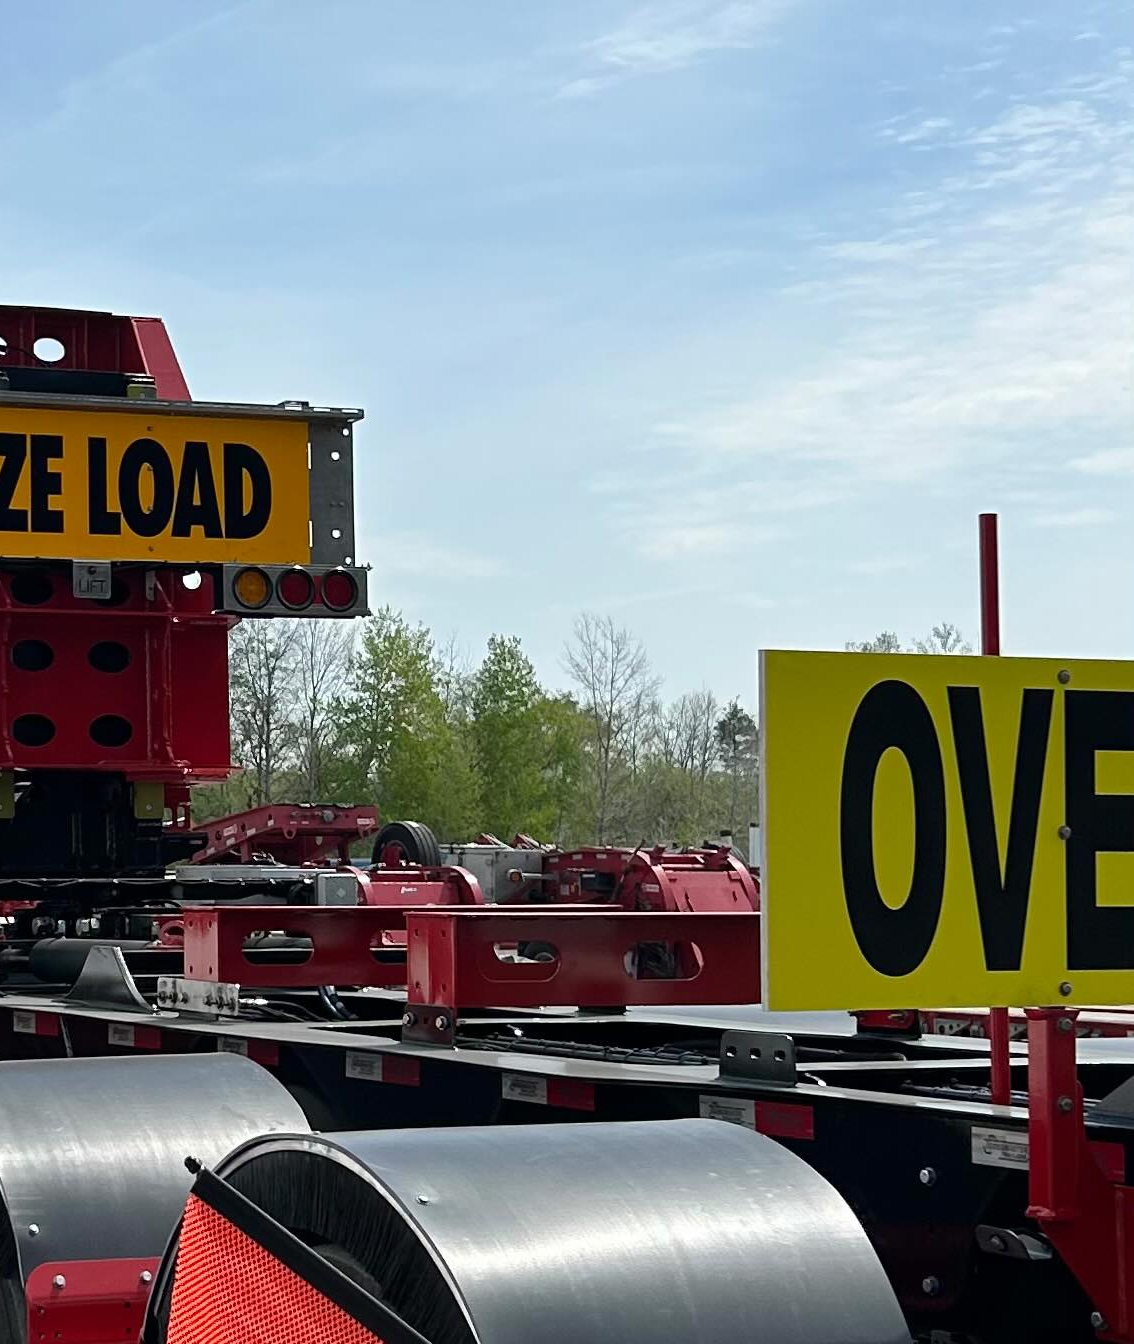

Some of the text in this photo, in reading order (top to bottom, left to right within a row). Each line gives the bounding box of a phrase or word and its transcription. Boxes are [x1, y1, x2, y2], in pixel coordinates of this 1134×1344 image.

[88, 436, 272, 539] LOAD
[78, 579, 106, 593] LIFT
[841, 680, 1134, 977] OVE
